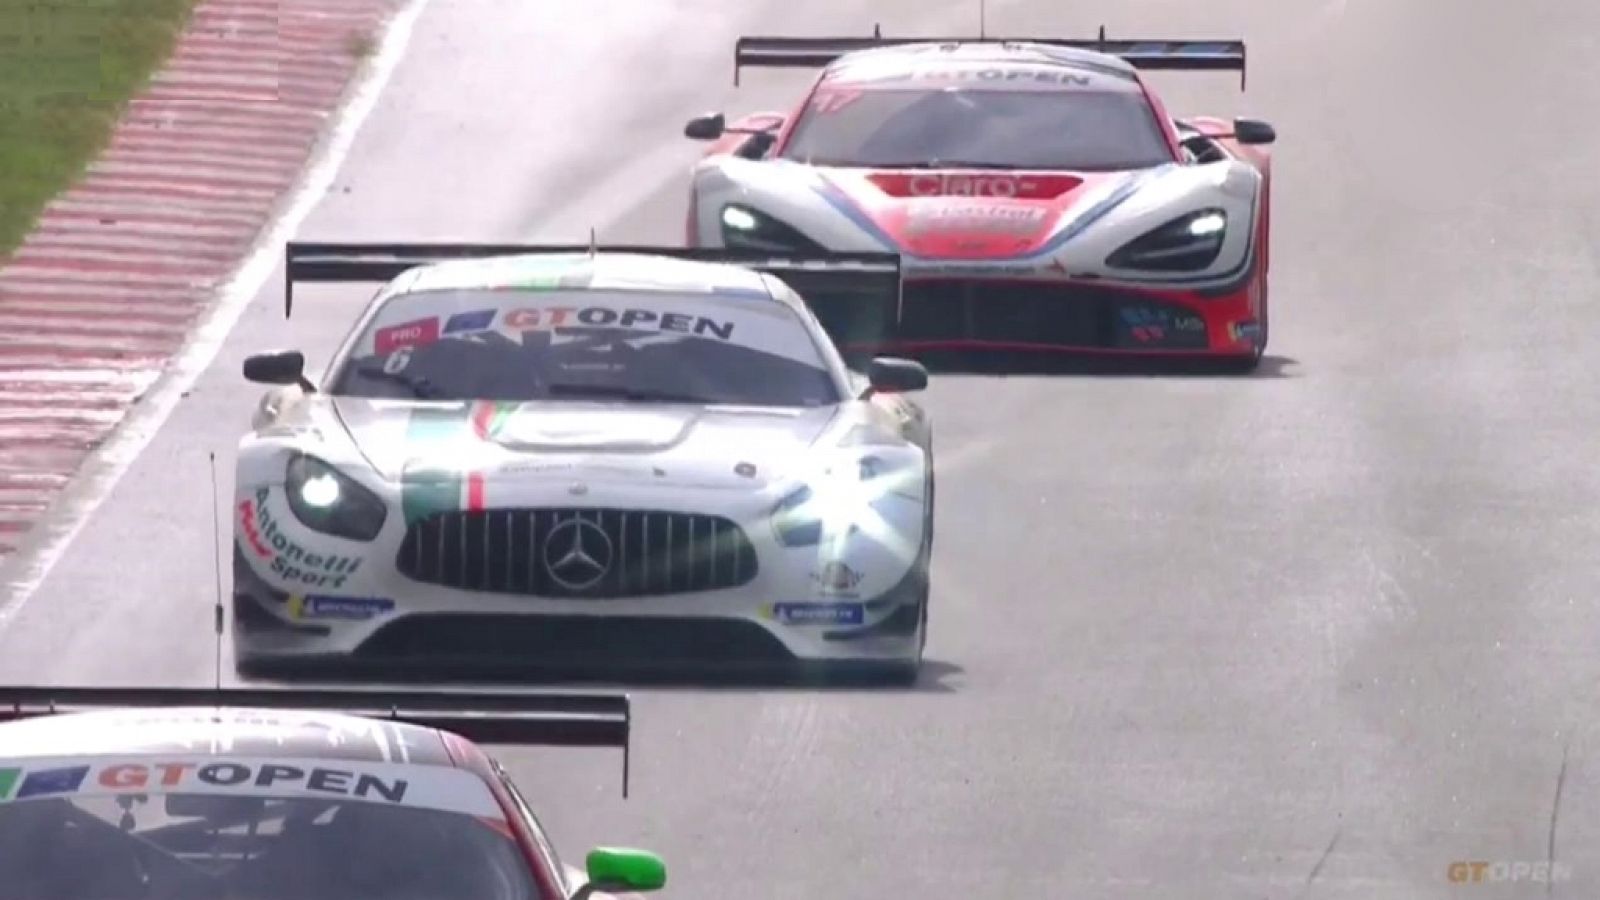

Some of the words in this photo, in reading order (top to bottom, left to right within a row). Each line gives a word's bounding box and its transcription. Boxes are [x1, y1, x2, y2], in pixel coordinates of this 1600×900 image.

[910, 174, 1016, 197] Claro
[390, 325, 422, 342] PRO
[504, 307, 735, 340] GTOPEN
[383, 346, 411, 375] 6
[255, 484, 363, 574] Antonelli
[271, 556, 347, 588] Sport
[97, 762, 408, 802] GTOPEN
